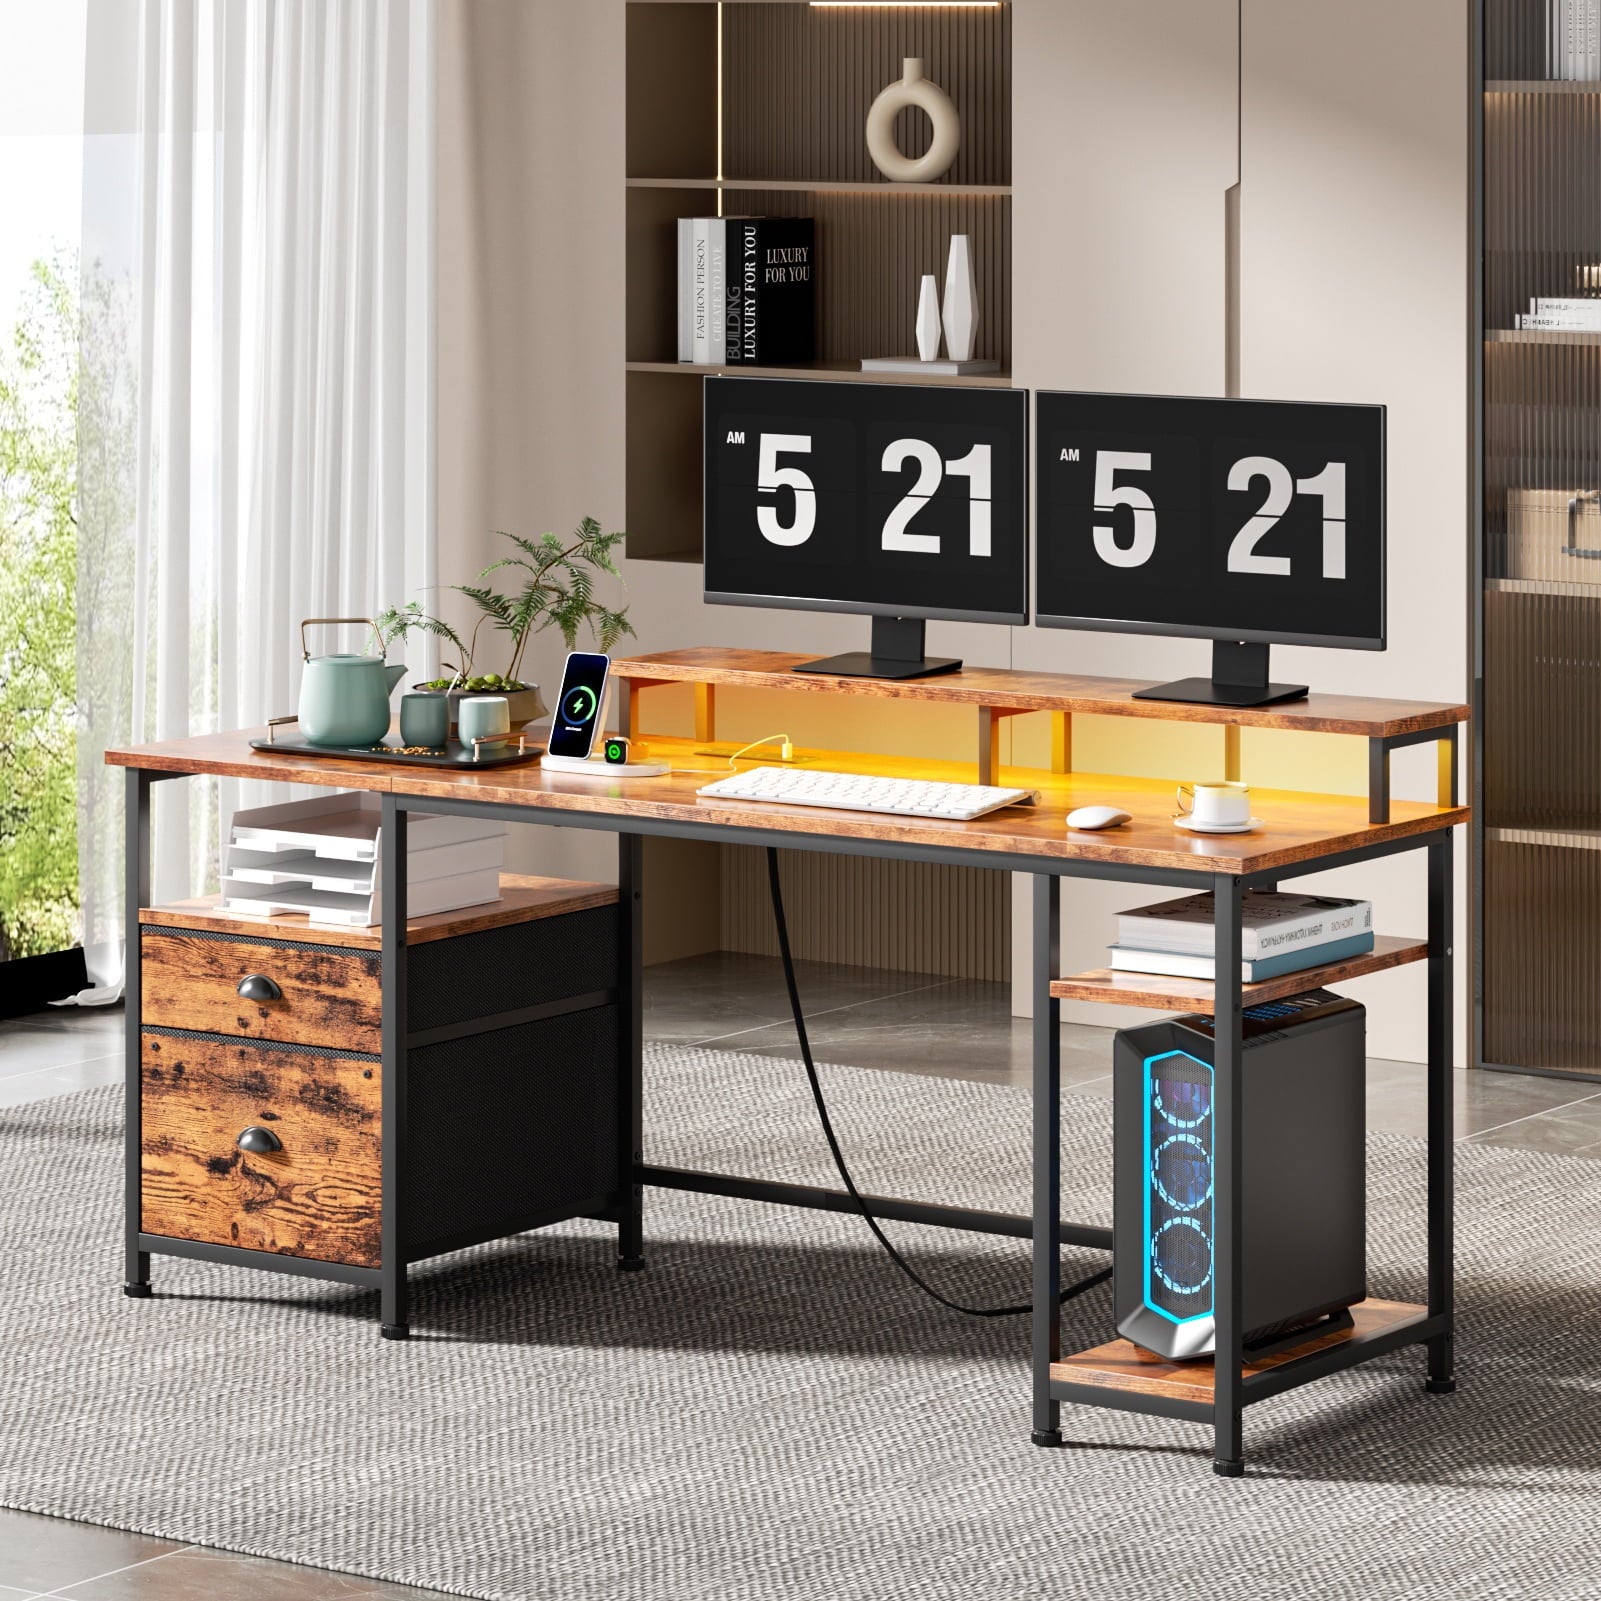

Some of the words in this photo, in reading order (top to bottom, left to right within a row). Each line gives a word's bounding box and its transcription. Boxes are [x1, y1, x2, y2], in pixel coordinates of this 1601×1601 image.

[744, 226, 756, 257] YOU
[767, 247, 809, 264] LUXURY
[696, 239, 705, 284] PERSON
[744, 262, 756, 292] FOR
[765, 268, 786, 283] FOR
[789, 266, 810, 282] YOU
[712, 275, 722, 291] TO
[696, 287, 705, 339] FASHION
[712, 295, 722, 342] CREATE
[727, 286, 741, 360] BUILDING
[744, 295, 756, 359] LUXURY
[726, 431, 745, 444] AM
[1059, 448, 1080, 461] AM
[756, 433, 816, 547] 5
[881, 438, 991, 557] 21
[1092, 450, 1157, 568] 5
[1227, 456, 1346, 579] 21
